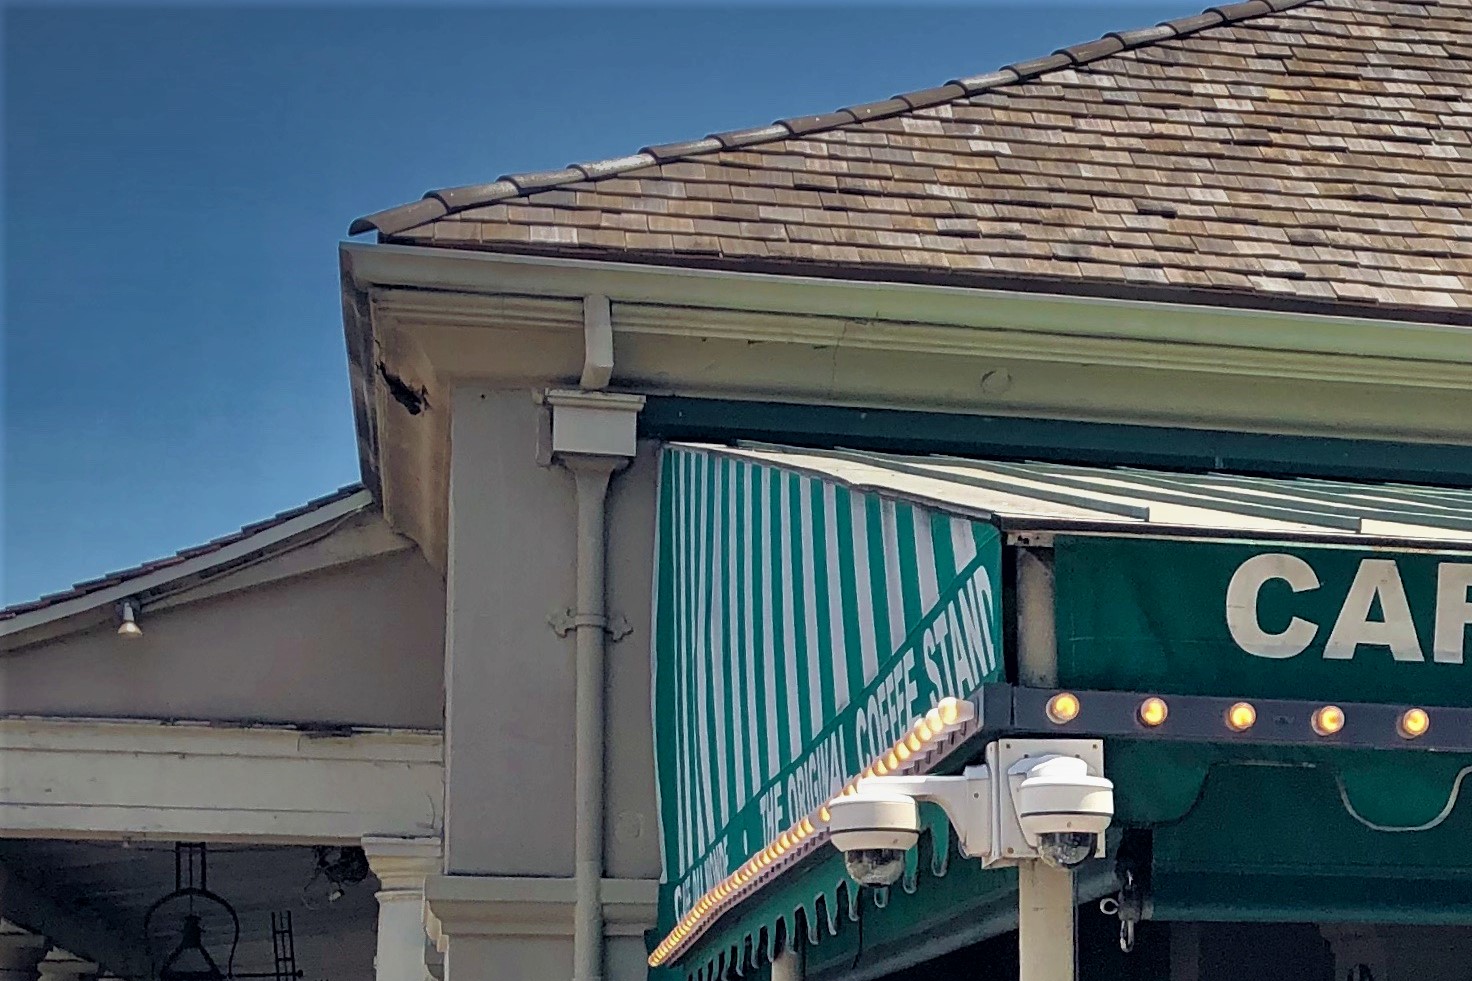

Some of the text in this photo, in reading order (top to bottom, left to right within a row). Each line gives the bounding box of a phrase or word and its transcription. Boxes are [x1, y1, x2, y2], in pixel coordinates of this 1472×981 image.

[759, 565, 996, 848] THE ORIGINAL COFFEE STAND
